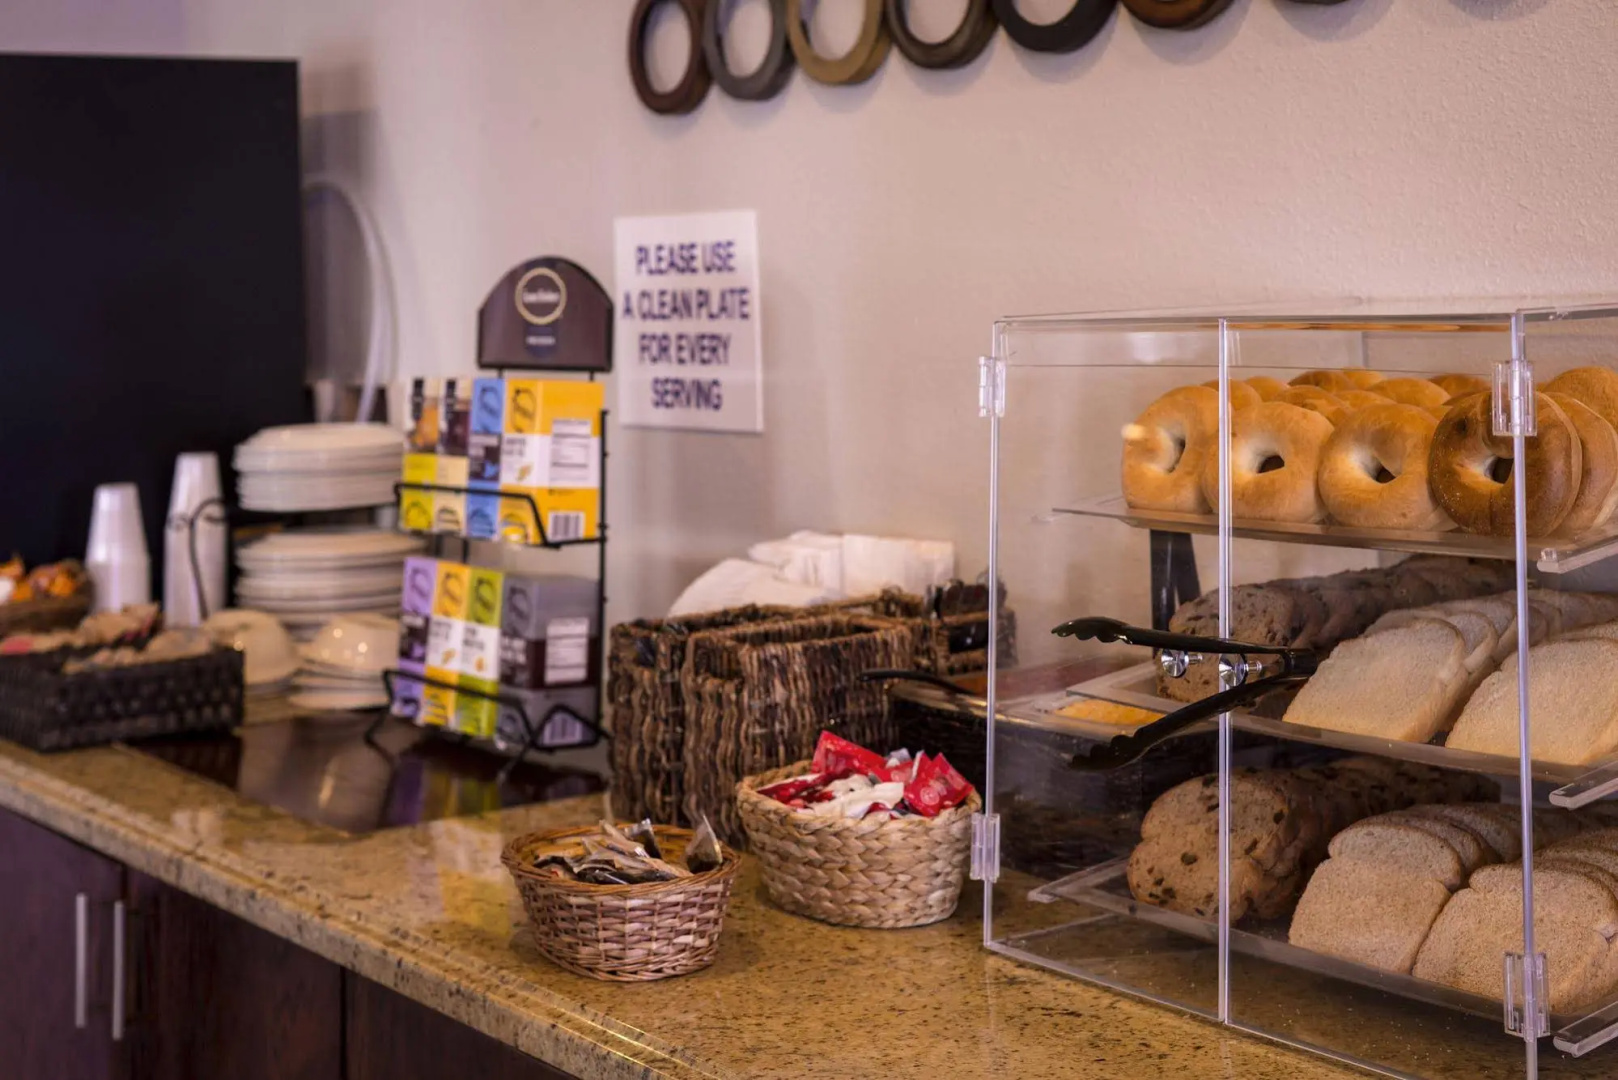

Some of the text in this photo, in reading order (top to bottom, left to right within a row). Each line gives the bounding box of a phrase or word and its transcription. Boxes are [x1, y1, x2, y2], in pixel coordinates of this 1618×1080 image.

[636, 241, 735, 274] PLEASE USE
[623, 288, 750, 319] A CLEAN PLATE
[639, 333, 731, 365] FOR EVERY
[652, 377, 722, 410] SERVING
